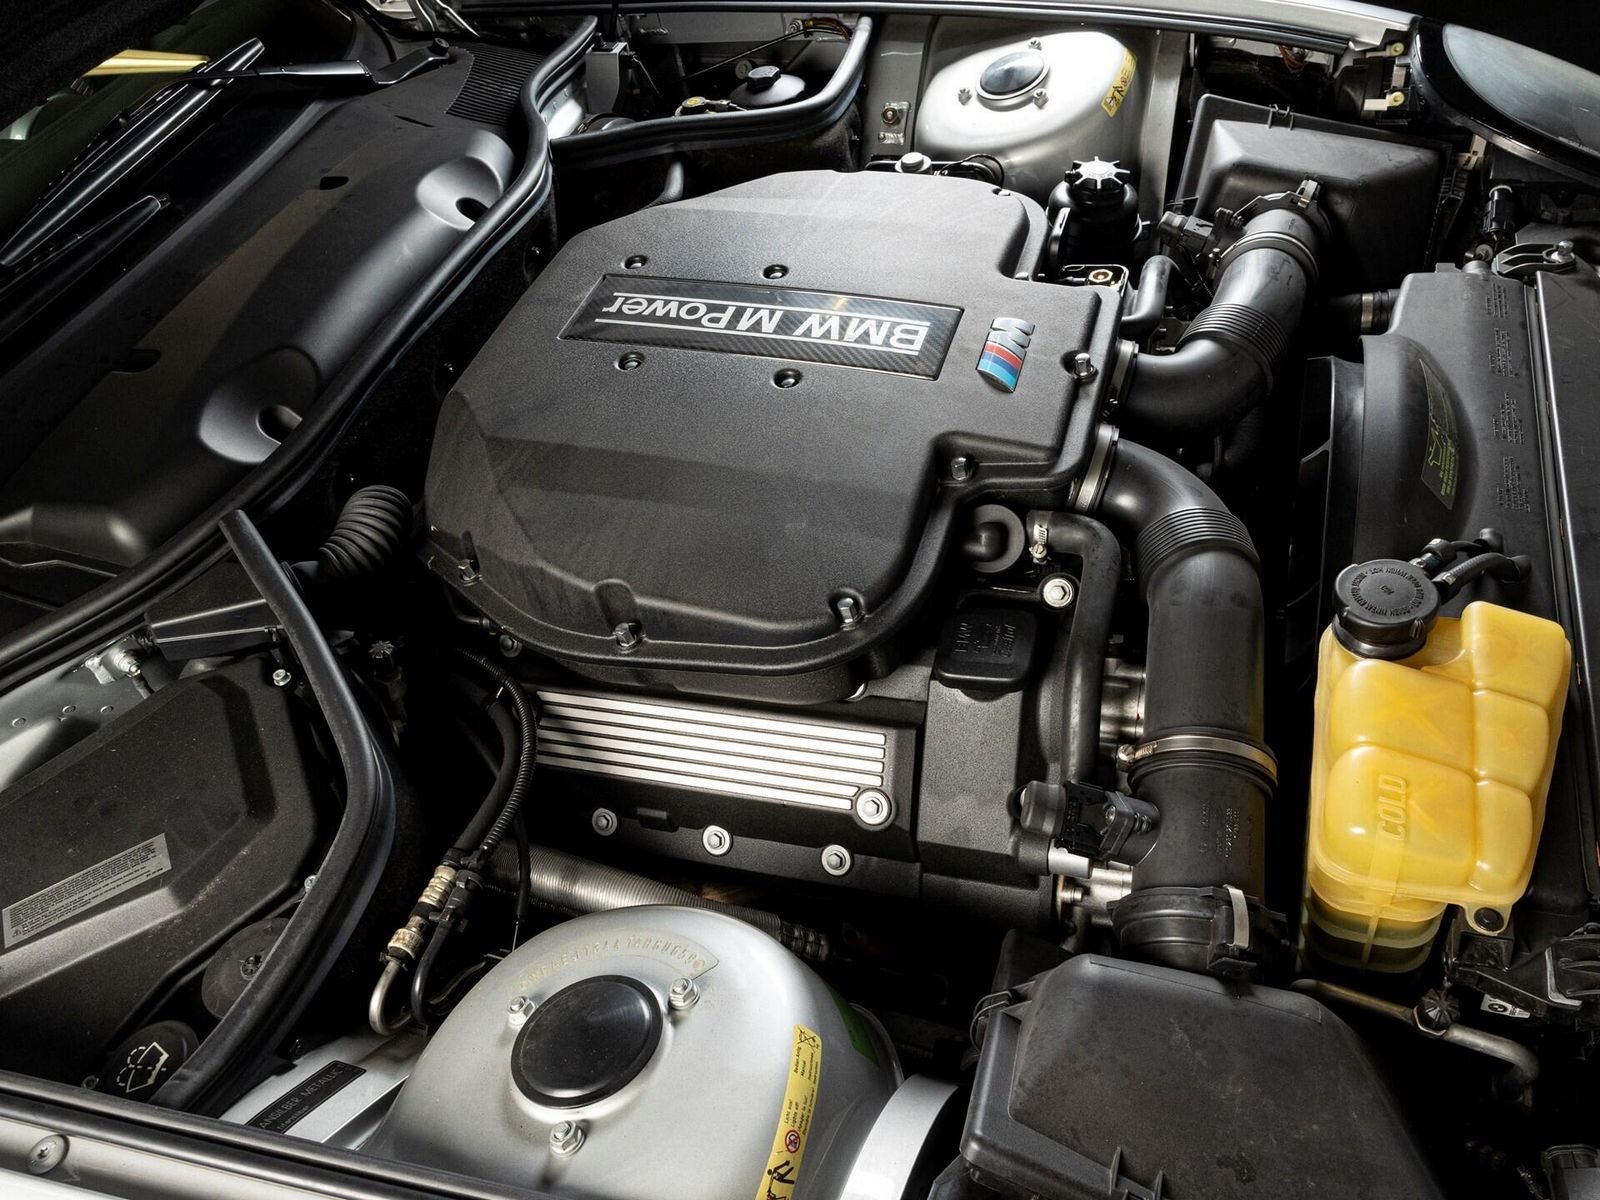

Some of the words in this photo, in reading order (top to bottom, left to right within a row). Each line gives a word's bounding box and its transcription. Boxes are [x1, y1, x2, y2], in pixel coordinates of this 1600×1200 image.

[792, 313, 930, 351] BMW
[1376, 773, 1408, 841] COLD
[259, 1096, 300, 1128] ANSILBER
[790, 1111, 798, 1127] Lights
